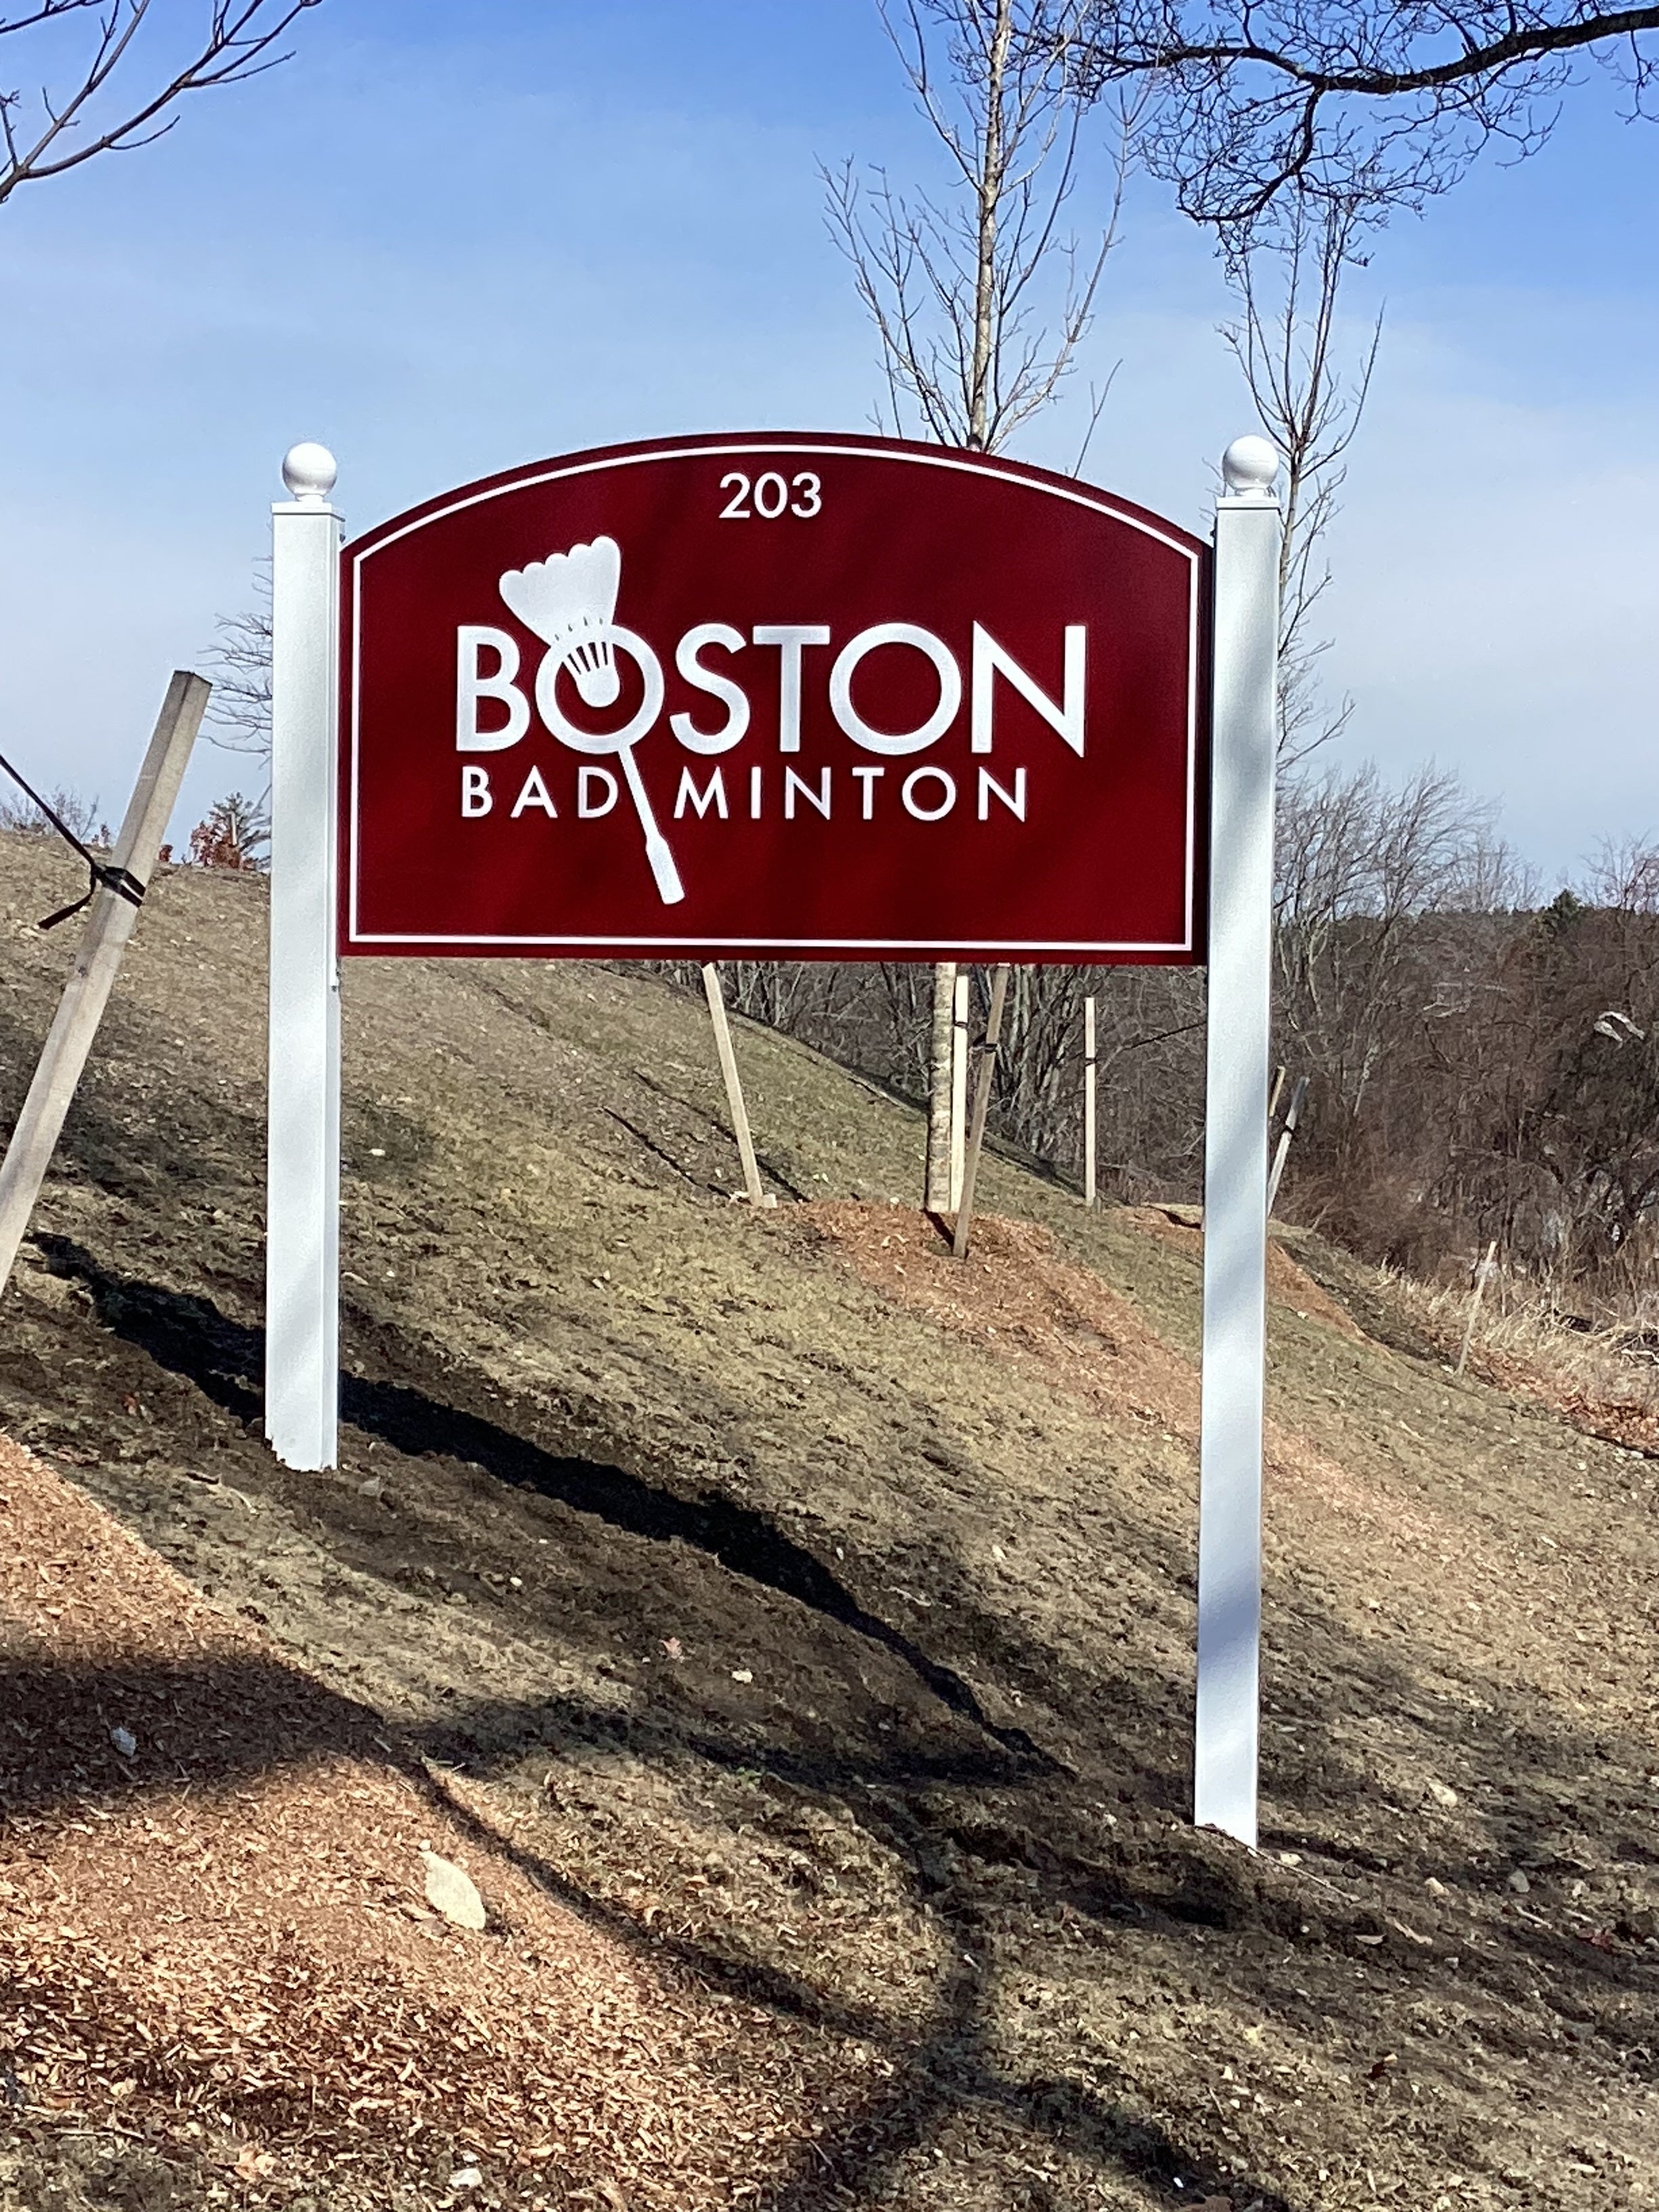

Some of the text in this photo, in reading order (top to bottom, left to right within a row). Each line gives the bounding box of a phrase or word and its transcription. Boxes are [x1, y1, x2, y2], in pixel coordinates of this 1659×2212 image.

[718, 472, 822, 518] 203
[455, 621, 1086, 758] BOSTON
[461, 765, 1027, 822] BADMINTON
